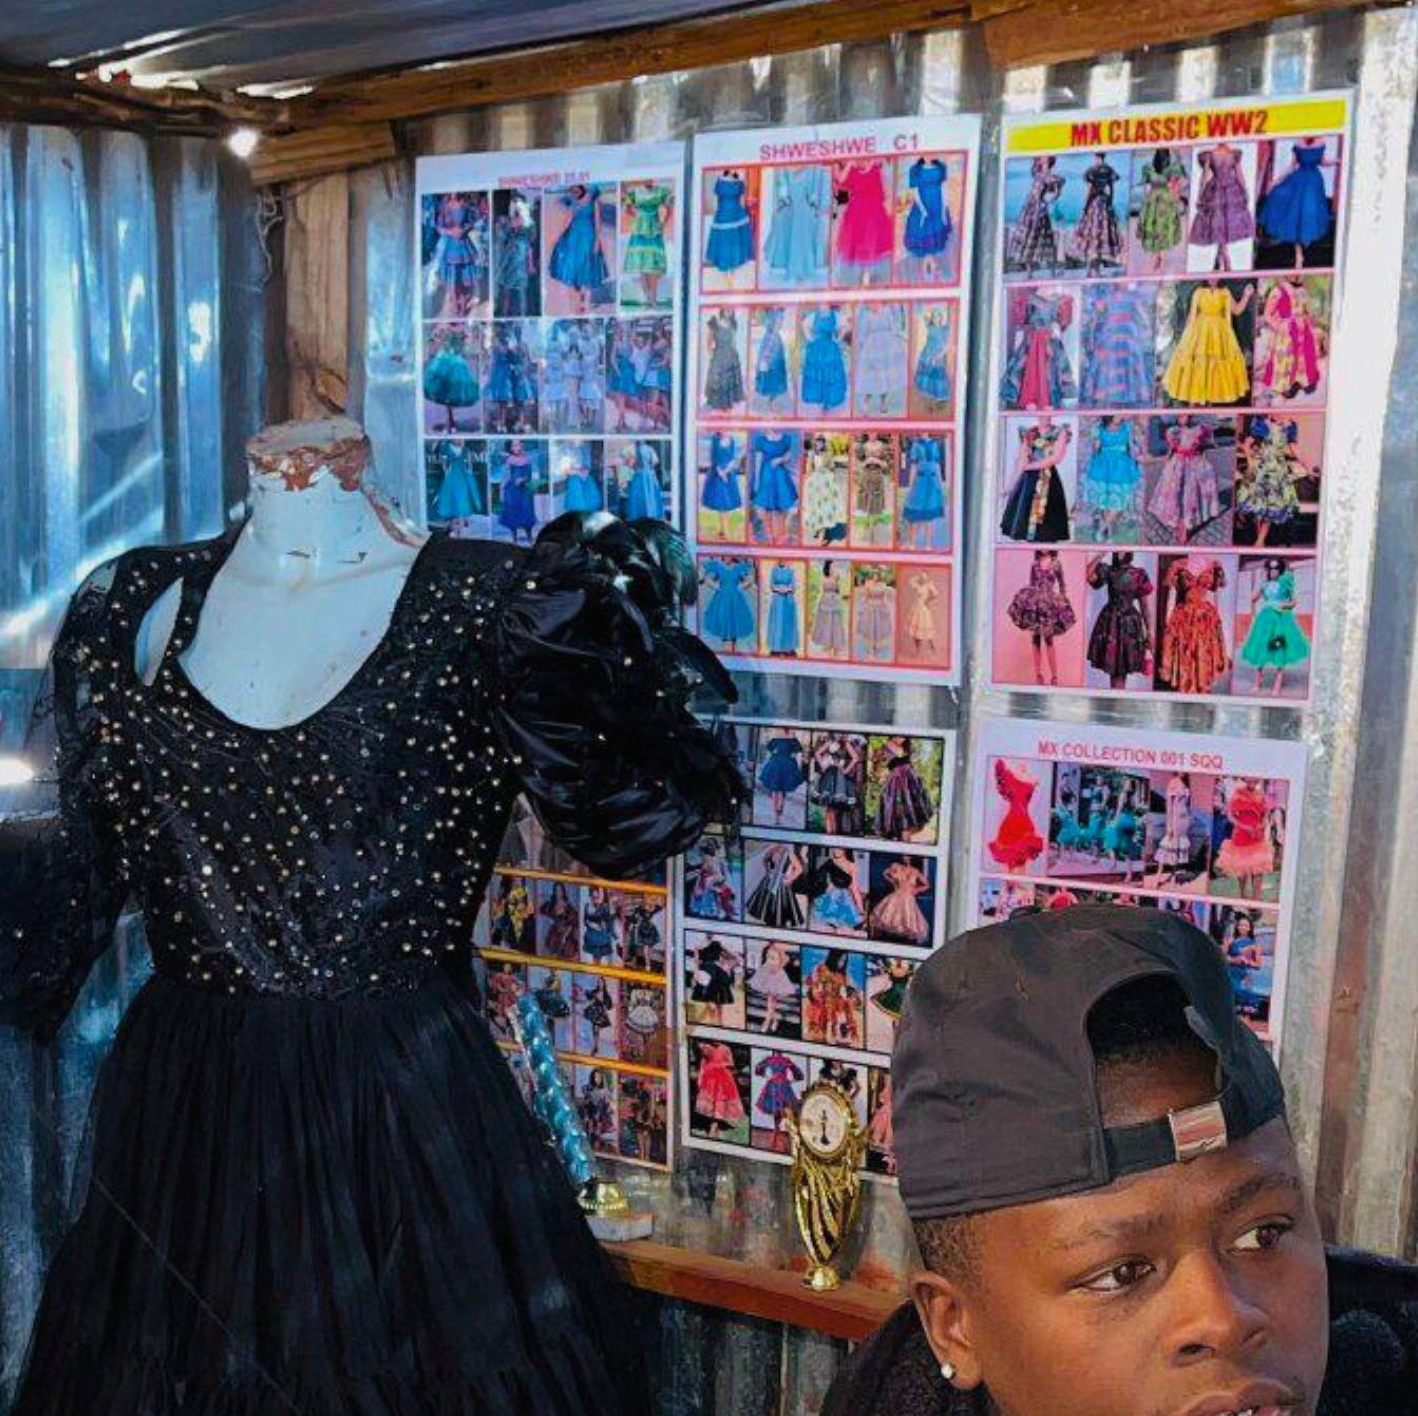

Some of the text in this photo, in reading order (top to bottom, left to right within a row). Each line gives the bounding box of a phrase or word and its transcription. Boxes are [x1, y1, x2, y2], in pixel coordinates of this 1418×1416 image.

[1071, 110, 1268, 147] MX CLASSIC WW2
[759, 132, 919, 161] SHWESHWE C1
[1037, 740, 1058, 757] MX
[1063, 742, 1156, 764] COLLECTION
